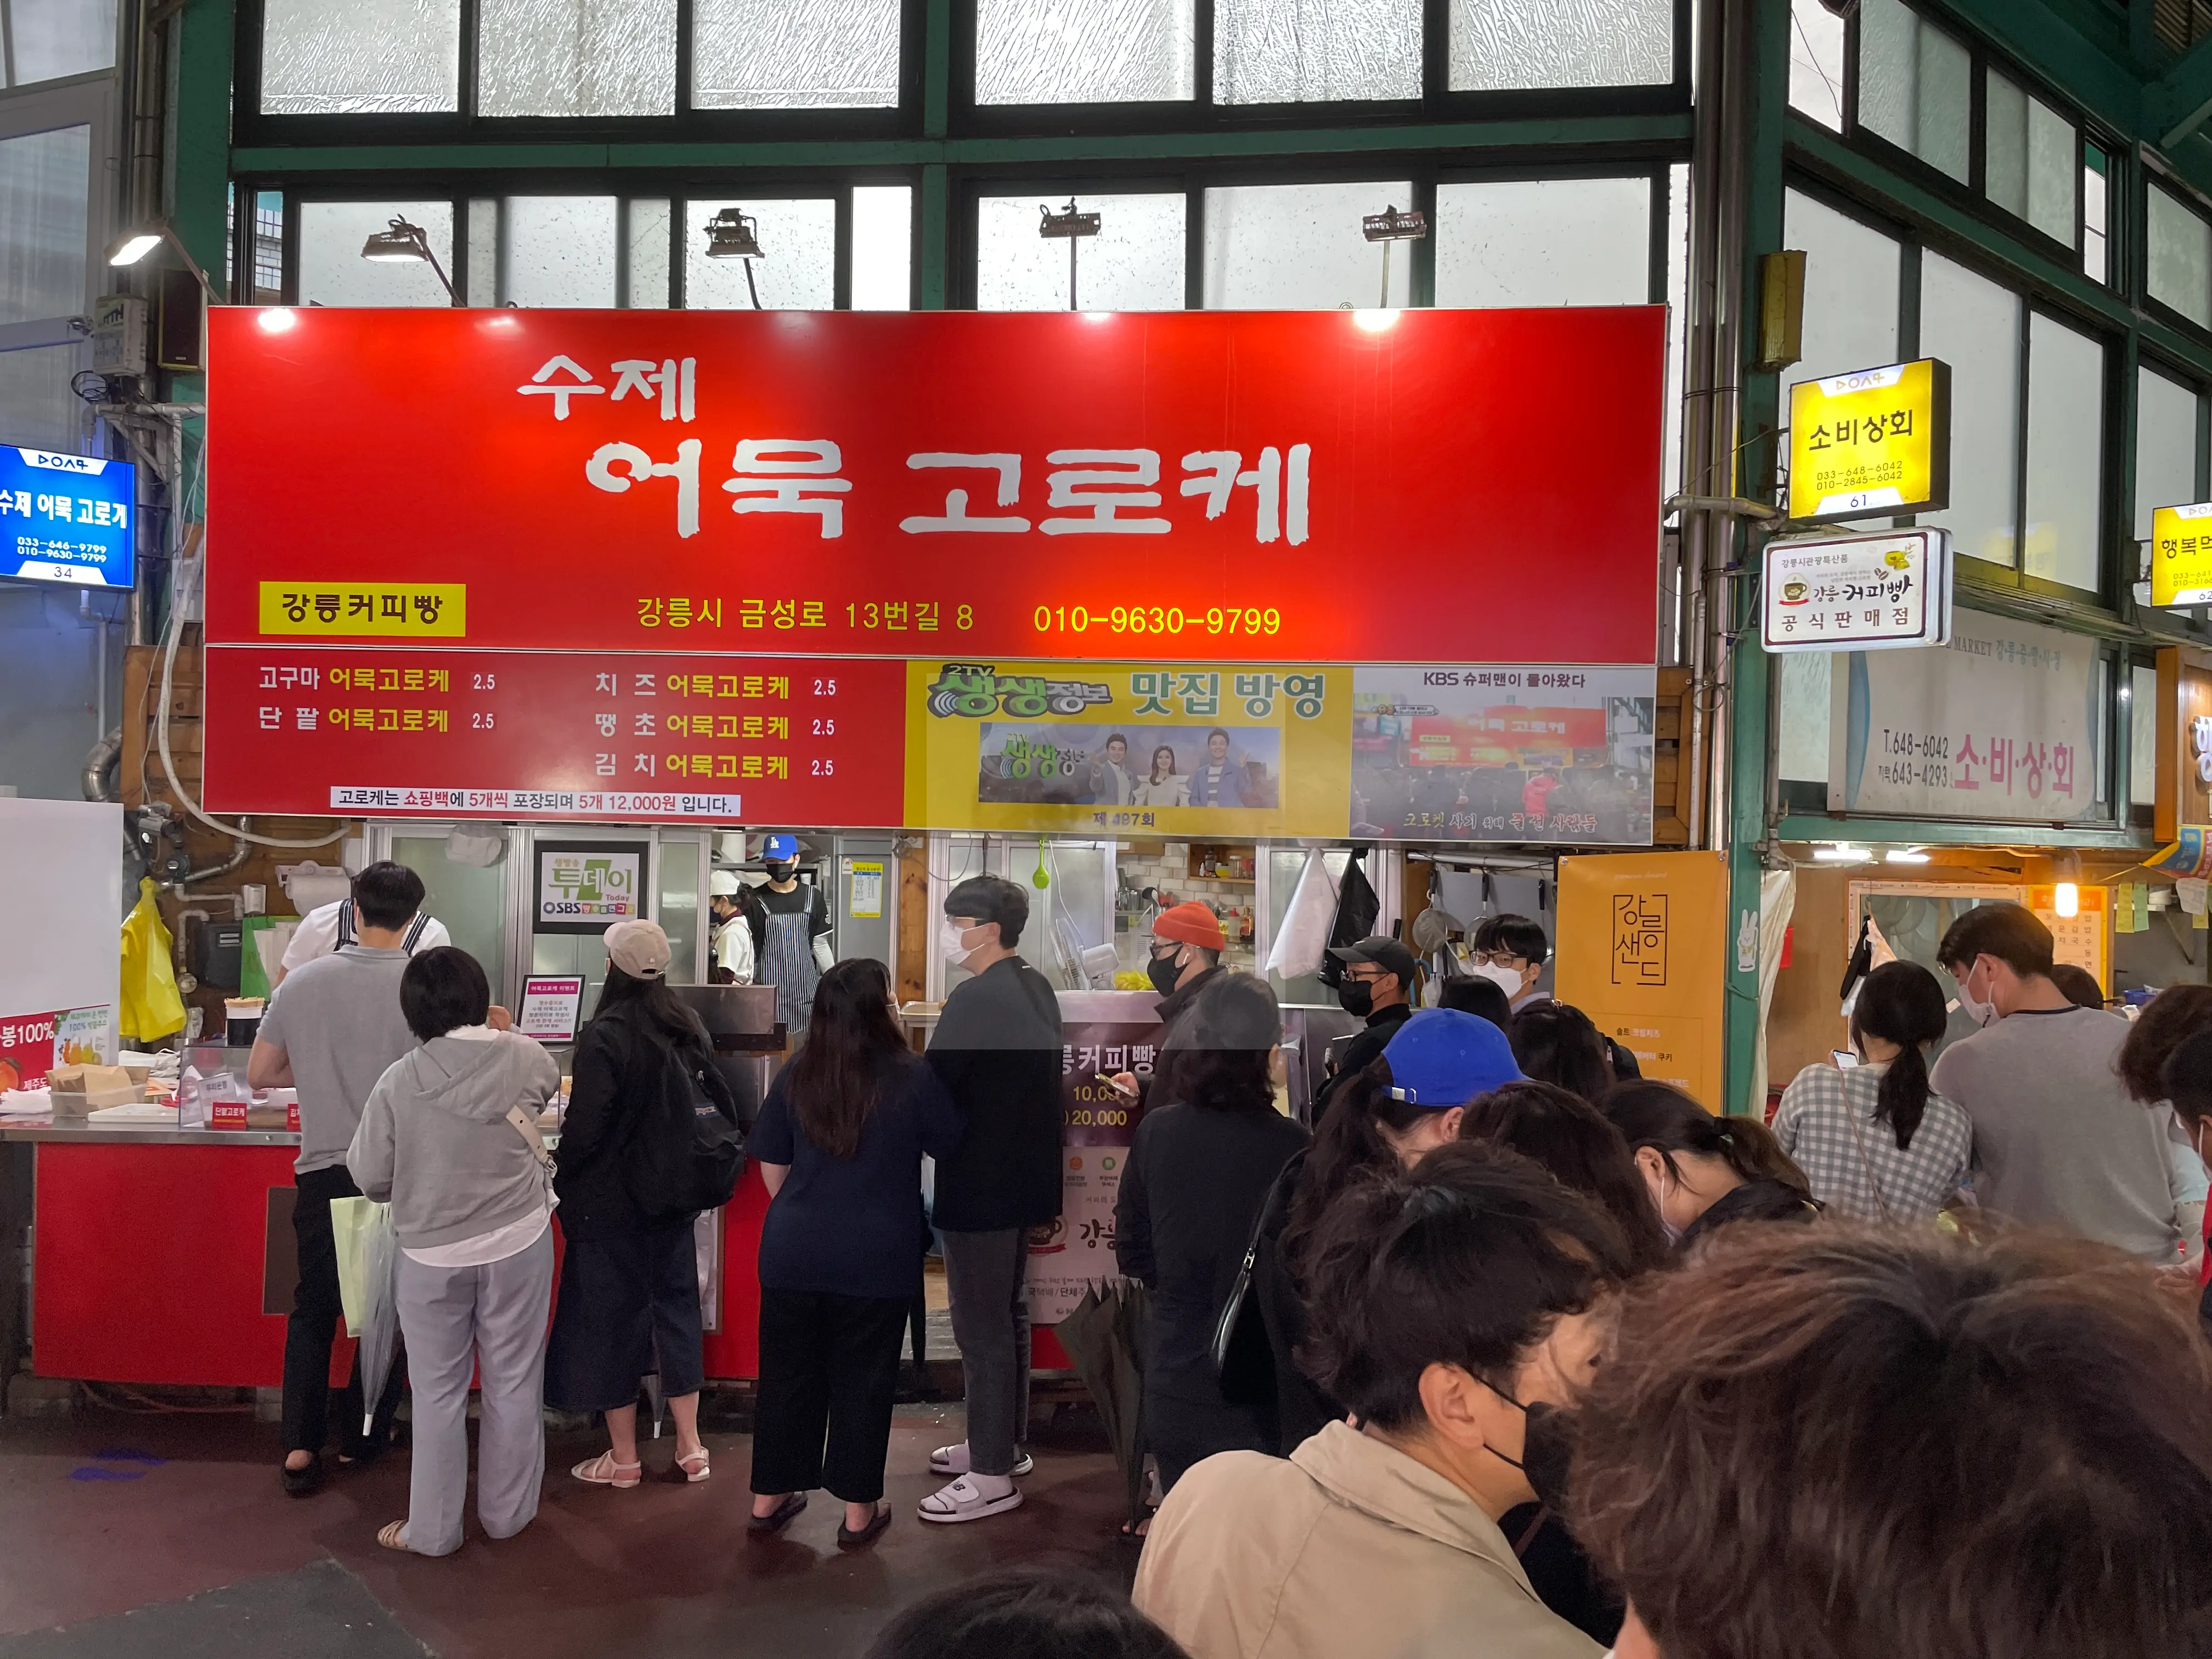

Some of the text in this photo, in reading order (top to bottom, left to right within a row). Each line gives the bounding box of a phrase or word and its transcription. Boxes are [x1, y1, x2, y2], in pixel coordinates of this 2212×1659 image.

[517, 355, 696, 422] 수제
[1809, 409, 1914, 450] 소비상회
[1816, 471, 1903, 490] 010-2845-6042
[1817, 460, 1903, 481] 033-648-6042
[586, 438, 1312, 546] 어묵 고로케
[1850, 494, 1867, 507] 61
[0, 489, 32, 518] 수제
[37, 494, 72, 522] 어묵
[17, 546, 107, 563] 010-9630-9799
[18, 536, 107, 553] 033-646-9799
[54, 566, 72, 579] 34
[1814, 585, 1839, 602] 강릉
[1842, 574, 1914, 603] 커피빵
[282, 594, 443, 624] 강릉커피빵
[636, 597, 1280, 635] 강릉시 금성로 13번길 8 010-9630-9799
[1781, 607, 1909, 632] 공식판매점
[1954, 636, 1992, 657] MARKET
[259, 667, 495, 692] 고구마 어묵고로케 2.5
[948, 665, 994, 676] 2TV
[1424, 672, 1585, 688] KBS 슈퍼맨이 돌아왔다
[596, 673, 837, 699] 치 즈 어묵고로케 2.5
[1131, 672, 1221, 716] 맛집
[1235, 674, 1326, 719] 방영
[259, 707, 282, 730] 단
[329, 708, 449, 732] 어묵고로케
[472, 714, 494, 730] 2.5
[634, 713, 656, 737] 초
[667, 715, 789, 740] 어묵고로케
[812, 719, 835, 736] 2.5
[1884, 729, 1948, 759] T.648-6042
[595, 753, 833, 780] 김 치 어묵고로케 2.5
[1893, 761, 1948, 788] 643-4293
[339, 790, 732, 813] 고로케는 쇼핑백에 5개씩 포장되며 5개 12,000원 입니다.
[770, 837, 780, 849] LA
[548, 867, 632, 900] 투데이
[556, 902, 581, 914] SBS
[606, 894, 630, 902] Today
[1658, 1053, 1672, 1062] 쿠키
[215, 1107, 245, 1116] 단팥고로케
